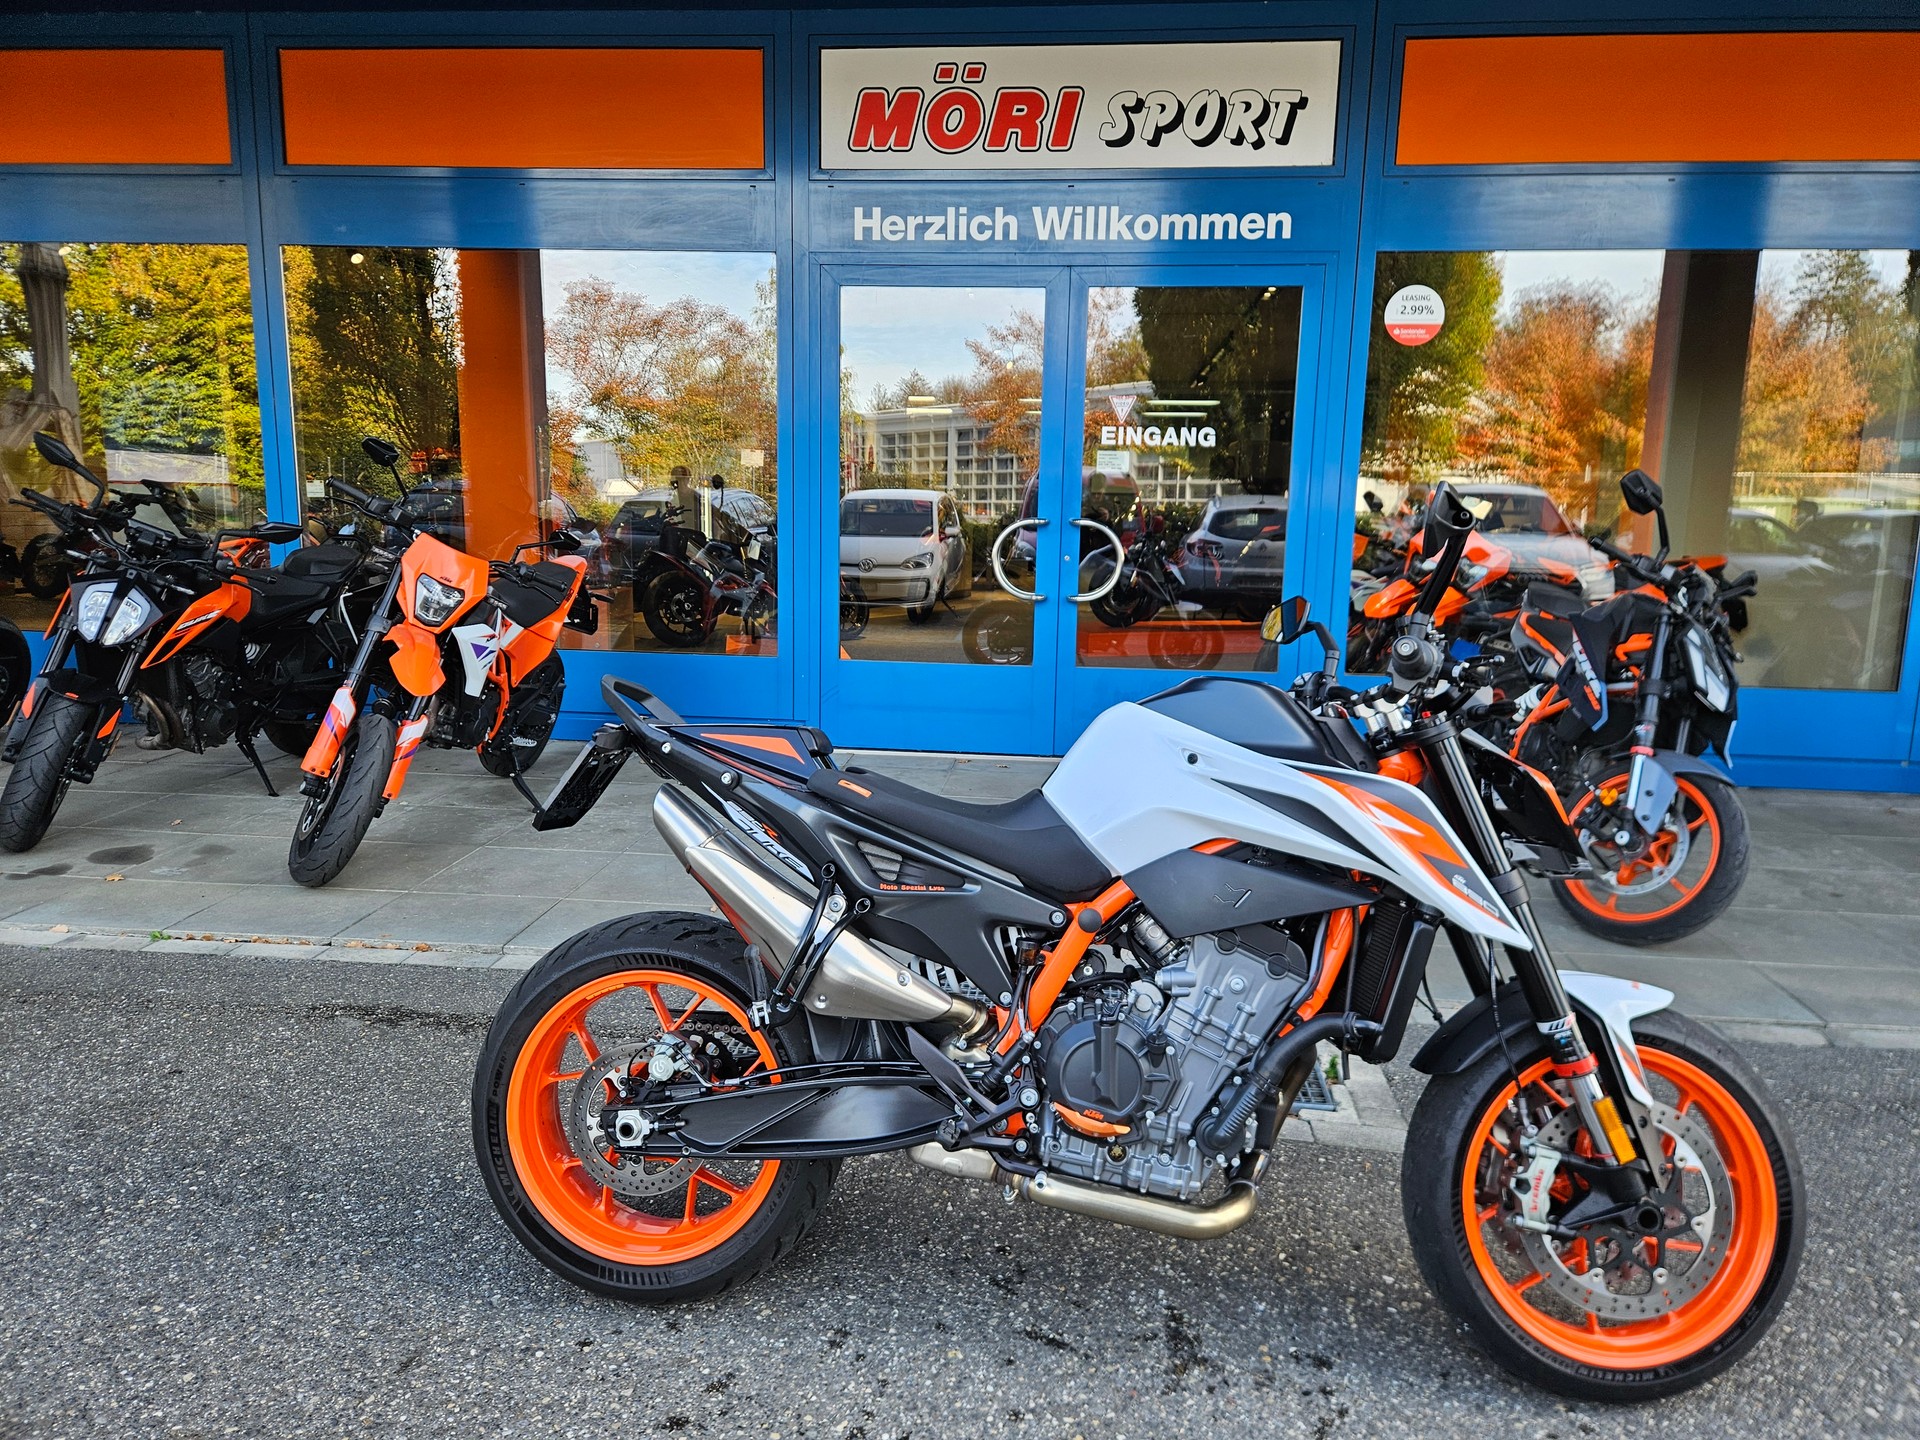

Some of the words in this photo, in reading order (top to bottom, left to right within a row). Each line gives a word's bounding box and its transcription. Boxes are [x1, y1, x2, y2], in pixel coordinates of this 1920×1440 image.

[848, 62, 1085, 154] MÖRI
[1099, 89, 1309, 150] SPORT
[853, 206, 1019, 241] Herzlich
[1032, 205, 1292, 241] Willkommen
[1401, 294, 1431, 302] LEASING
[1400, 304, 1435, 316] 2.99%
[1101, 426, 1217, 447] EINGANG
[880, 883, 898, 891] Moto
[1083, 1108, 1105, 1120] KTM
[488, 1103, 513, 1188] MICHELIN
[1576, 1365, 1656, 1383] MICHELIN
